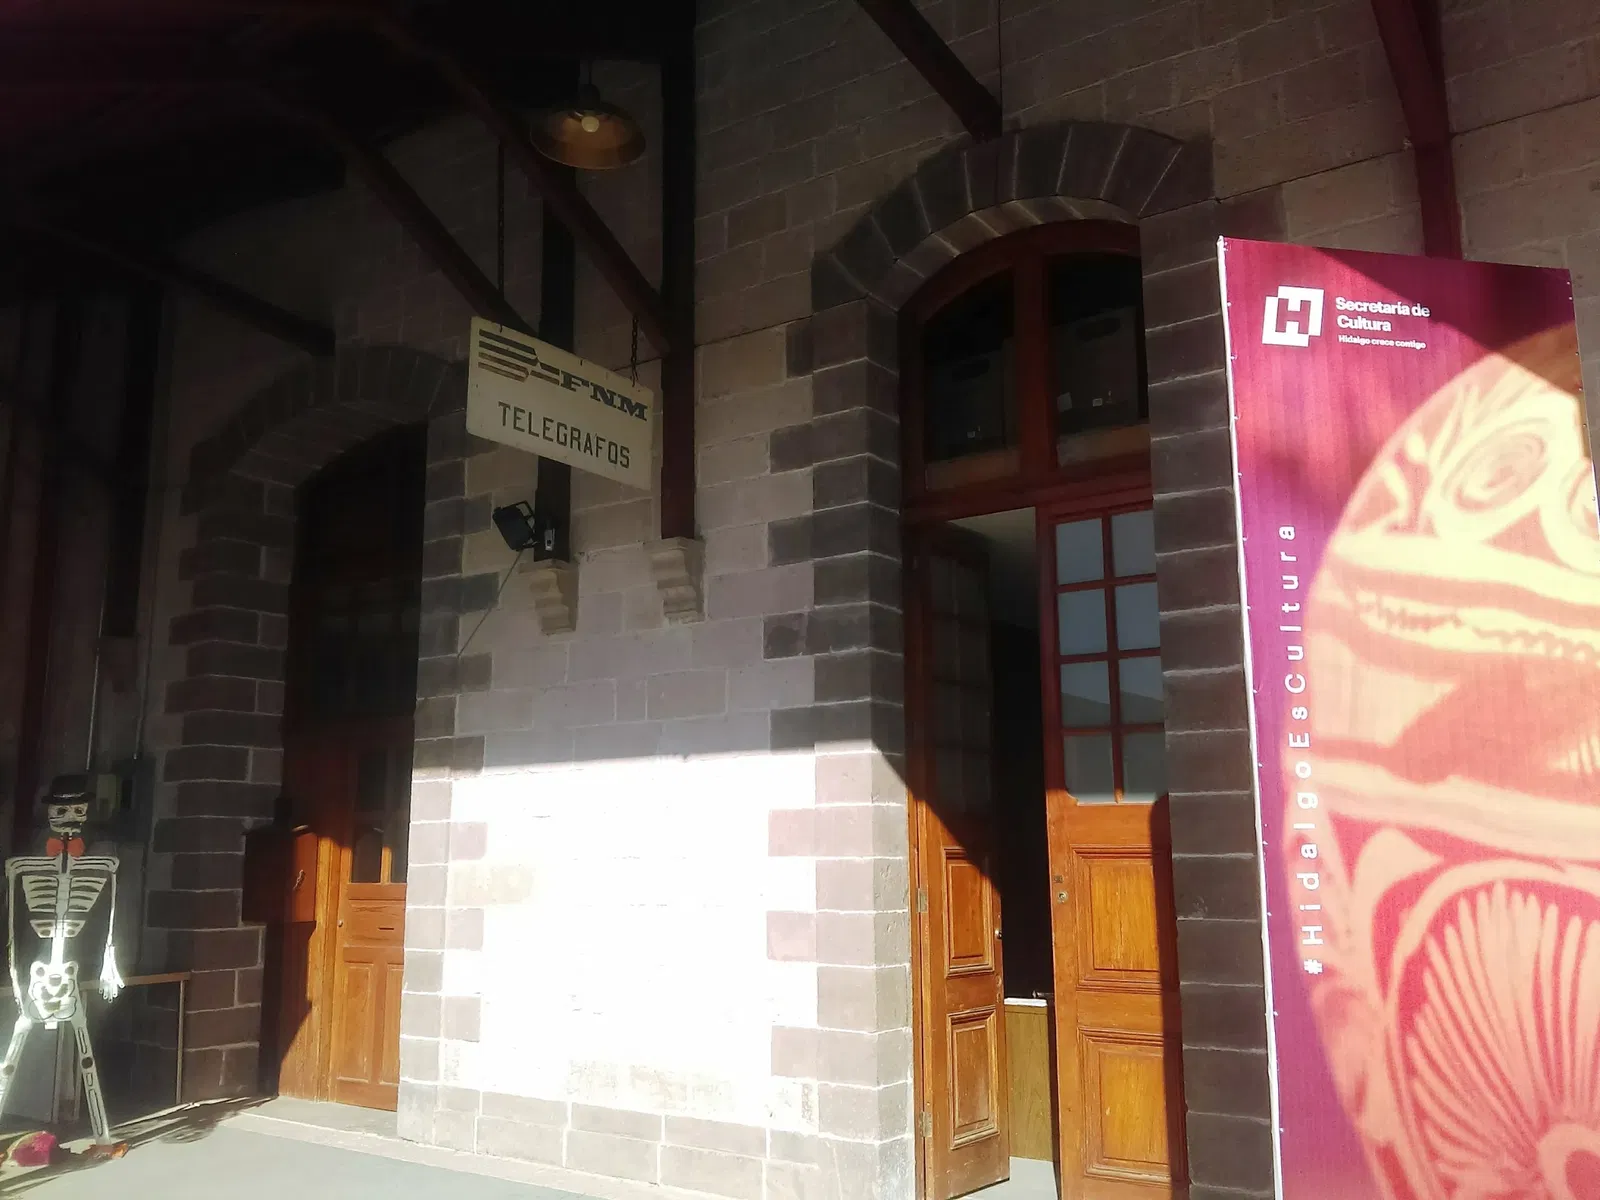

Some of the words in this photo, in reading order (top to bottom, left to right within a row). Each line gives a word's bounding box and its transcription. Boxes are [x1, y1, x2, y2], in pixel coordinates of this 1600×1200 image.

[1335, 296, 1410, 316] Secretaría
[1411, 302, 1431, 318] de
[1337, 315, 1392, 332] Cultura
[1338, 334, 1371, 346] Hidalgo
[1371, 338, 1394, 347] crece
[1395, 339, 1427, 350] contigo
[560, 370, 647, 422] FNM
[498, 401, 630, 469] TELEGRAFOS
[1278, 525, 1324, 975] #HidalgoEsCultura
